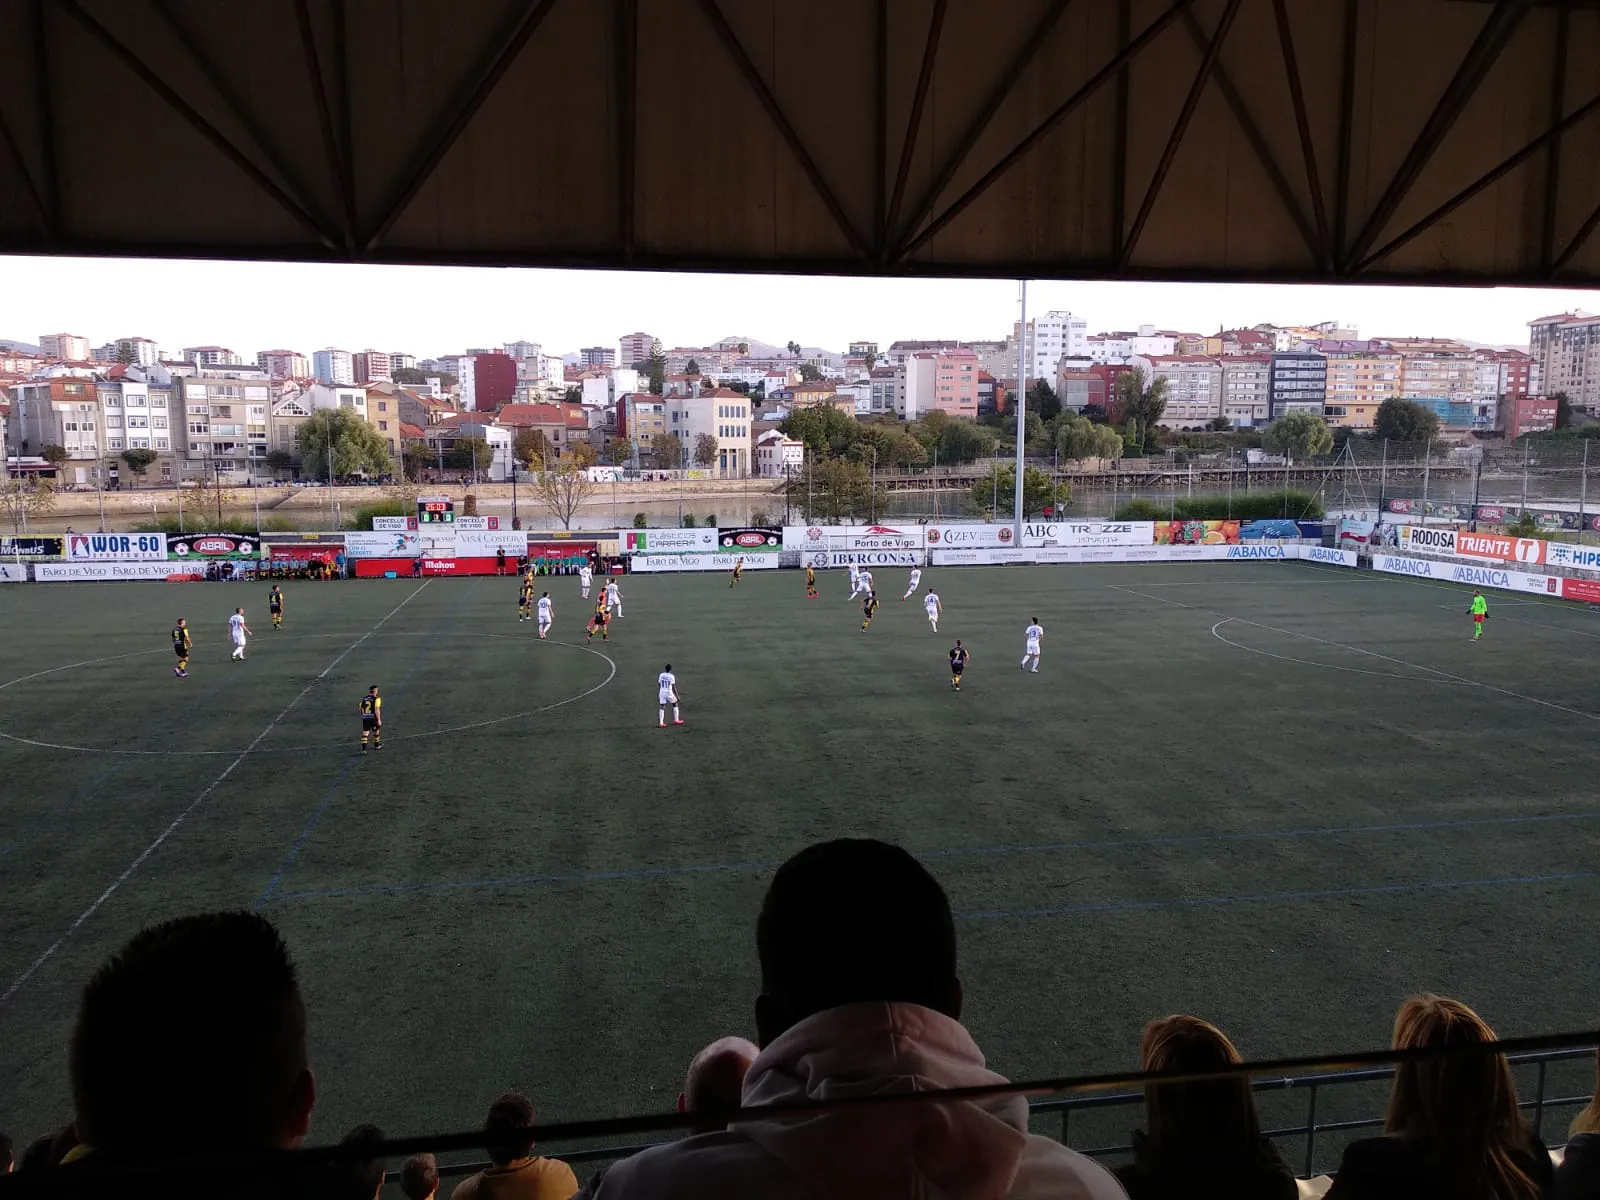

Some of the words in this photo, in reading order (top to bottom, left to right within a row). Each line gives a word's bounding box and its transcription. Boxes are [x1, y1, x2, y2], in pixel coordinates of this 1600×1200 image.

[425, 503, 447, 511] 26:03
[1481, 508, 1501, 518] ABRIL
[1023, 525, 1058, 537] ABC
[741, 536, 761, 544] ABRIL
[895, 539, 915, 548] Vigo
[1411, 529, 1455, 548] RODOSA
[91, 536, 160, 552] WOR-60
[199, 541, 231, 551] ABRIL
[1459, 537, 1510, 556] TRIENTE
[646, 558, 667, 566] FARO
[680, 558, 700, 566] VIGO
[712, 556, 732, 564] FARO
[745, 555, 766, 563] VIGO
[833, 553, 916, 565] IBERCONSA
[181, 565, 204, 574] FARO
[425, 561, 455, 569] Mahou
[42, 567, 67, 576] FARO
[69, 568, 81, 576] DE
[83, 567, 107, 575] VIGO
[112, 567, 136, 576] FARO
[138, 567, 151, 575] DE
[152, 566, 176, 575] VIGO
[954, 650, 960, 660] 7
[365, 701, 371, 714] 2
